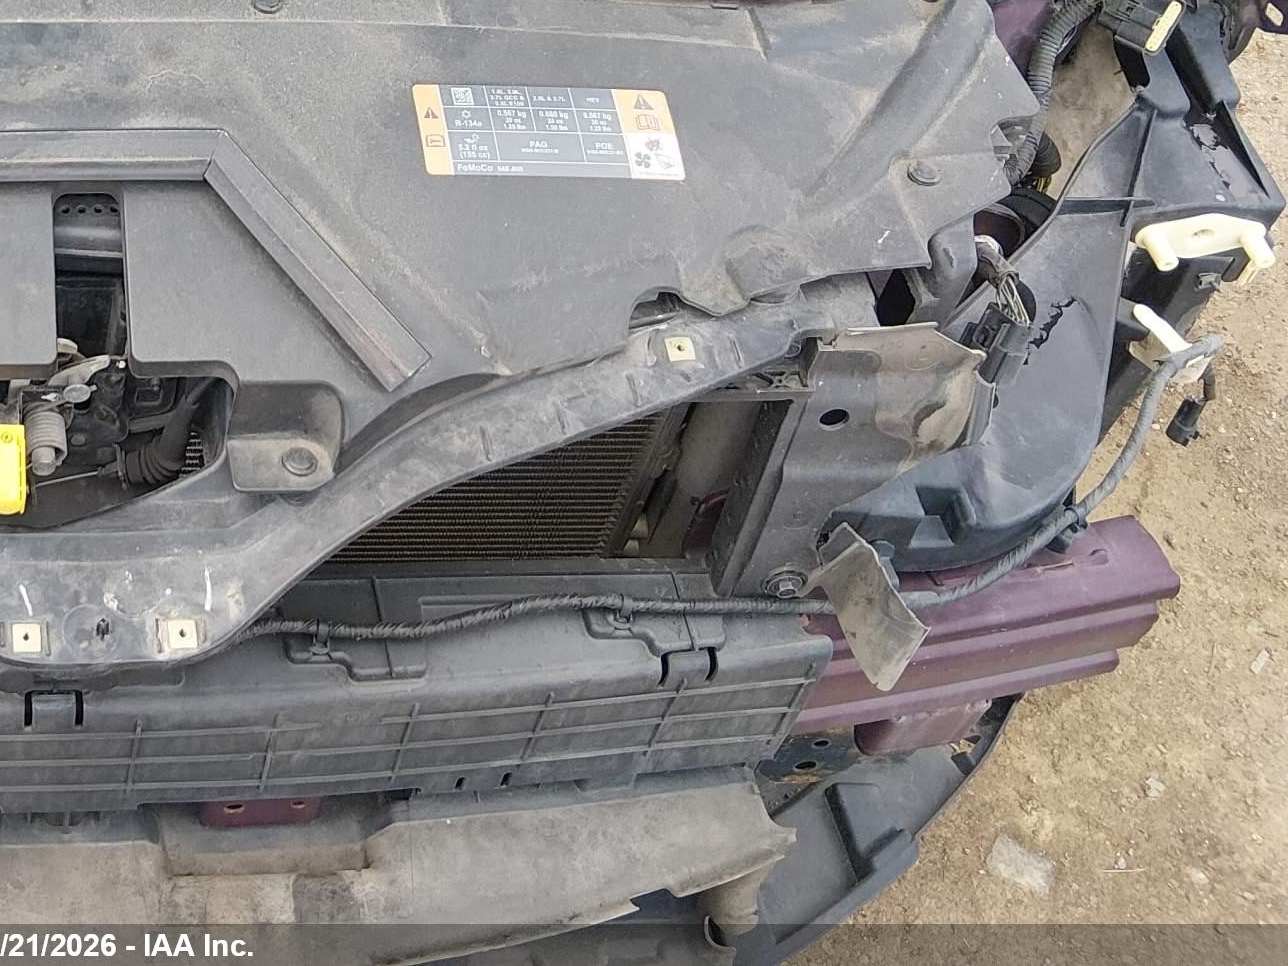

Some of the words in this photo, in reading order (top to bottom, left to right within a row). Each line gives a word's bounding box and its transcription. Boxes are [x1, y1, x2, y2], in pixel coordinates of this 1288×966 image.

[517, 110, 527, 119] kg
[559, 112, 569, 120] kg
[602, 113, 612, 121] kg
[454, 119, 483, 127] R-134a
[529, 140, 549, 148] PAG
[595, 142, 613, 150] POE
[457, 163, 494, 172] FoMoCo
